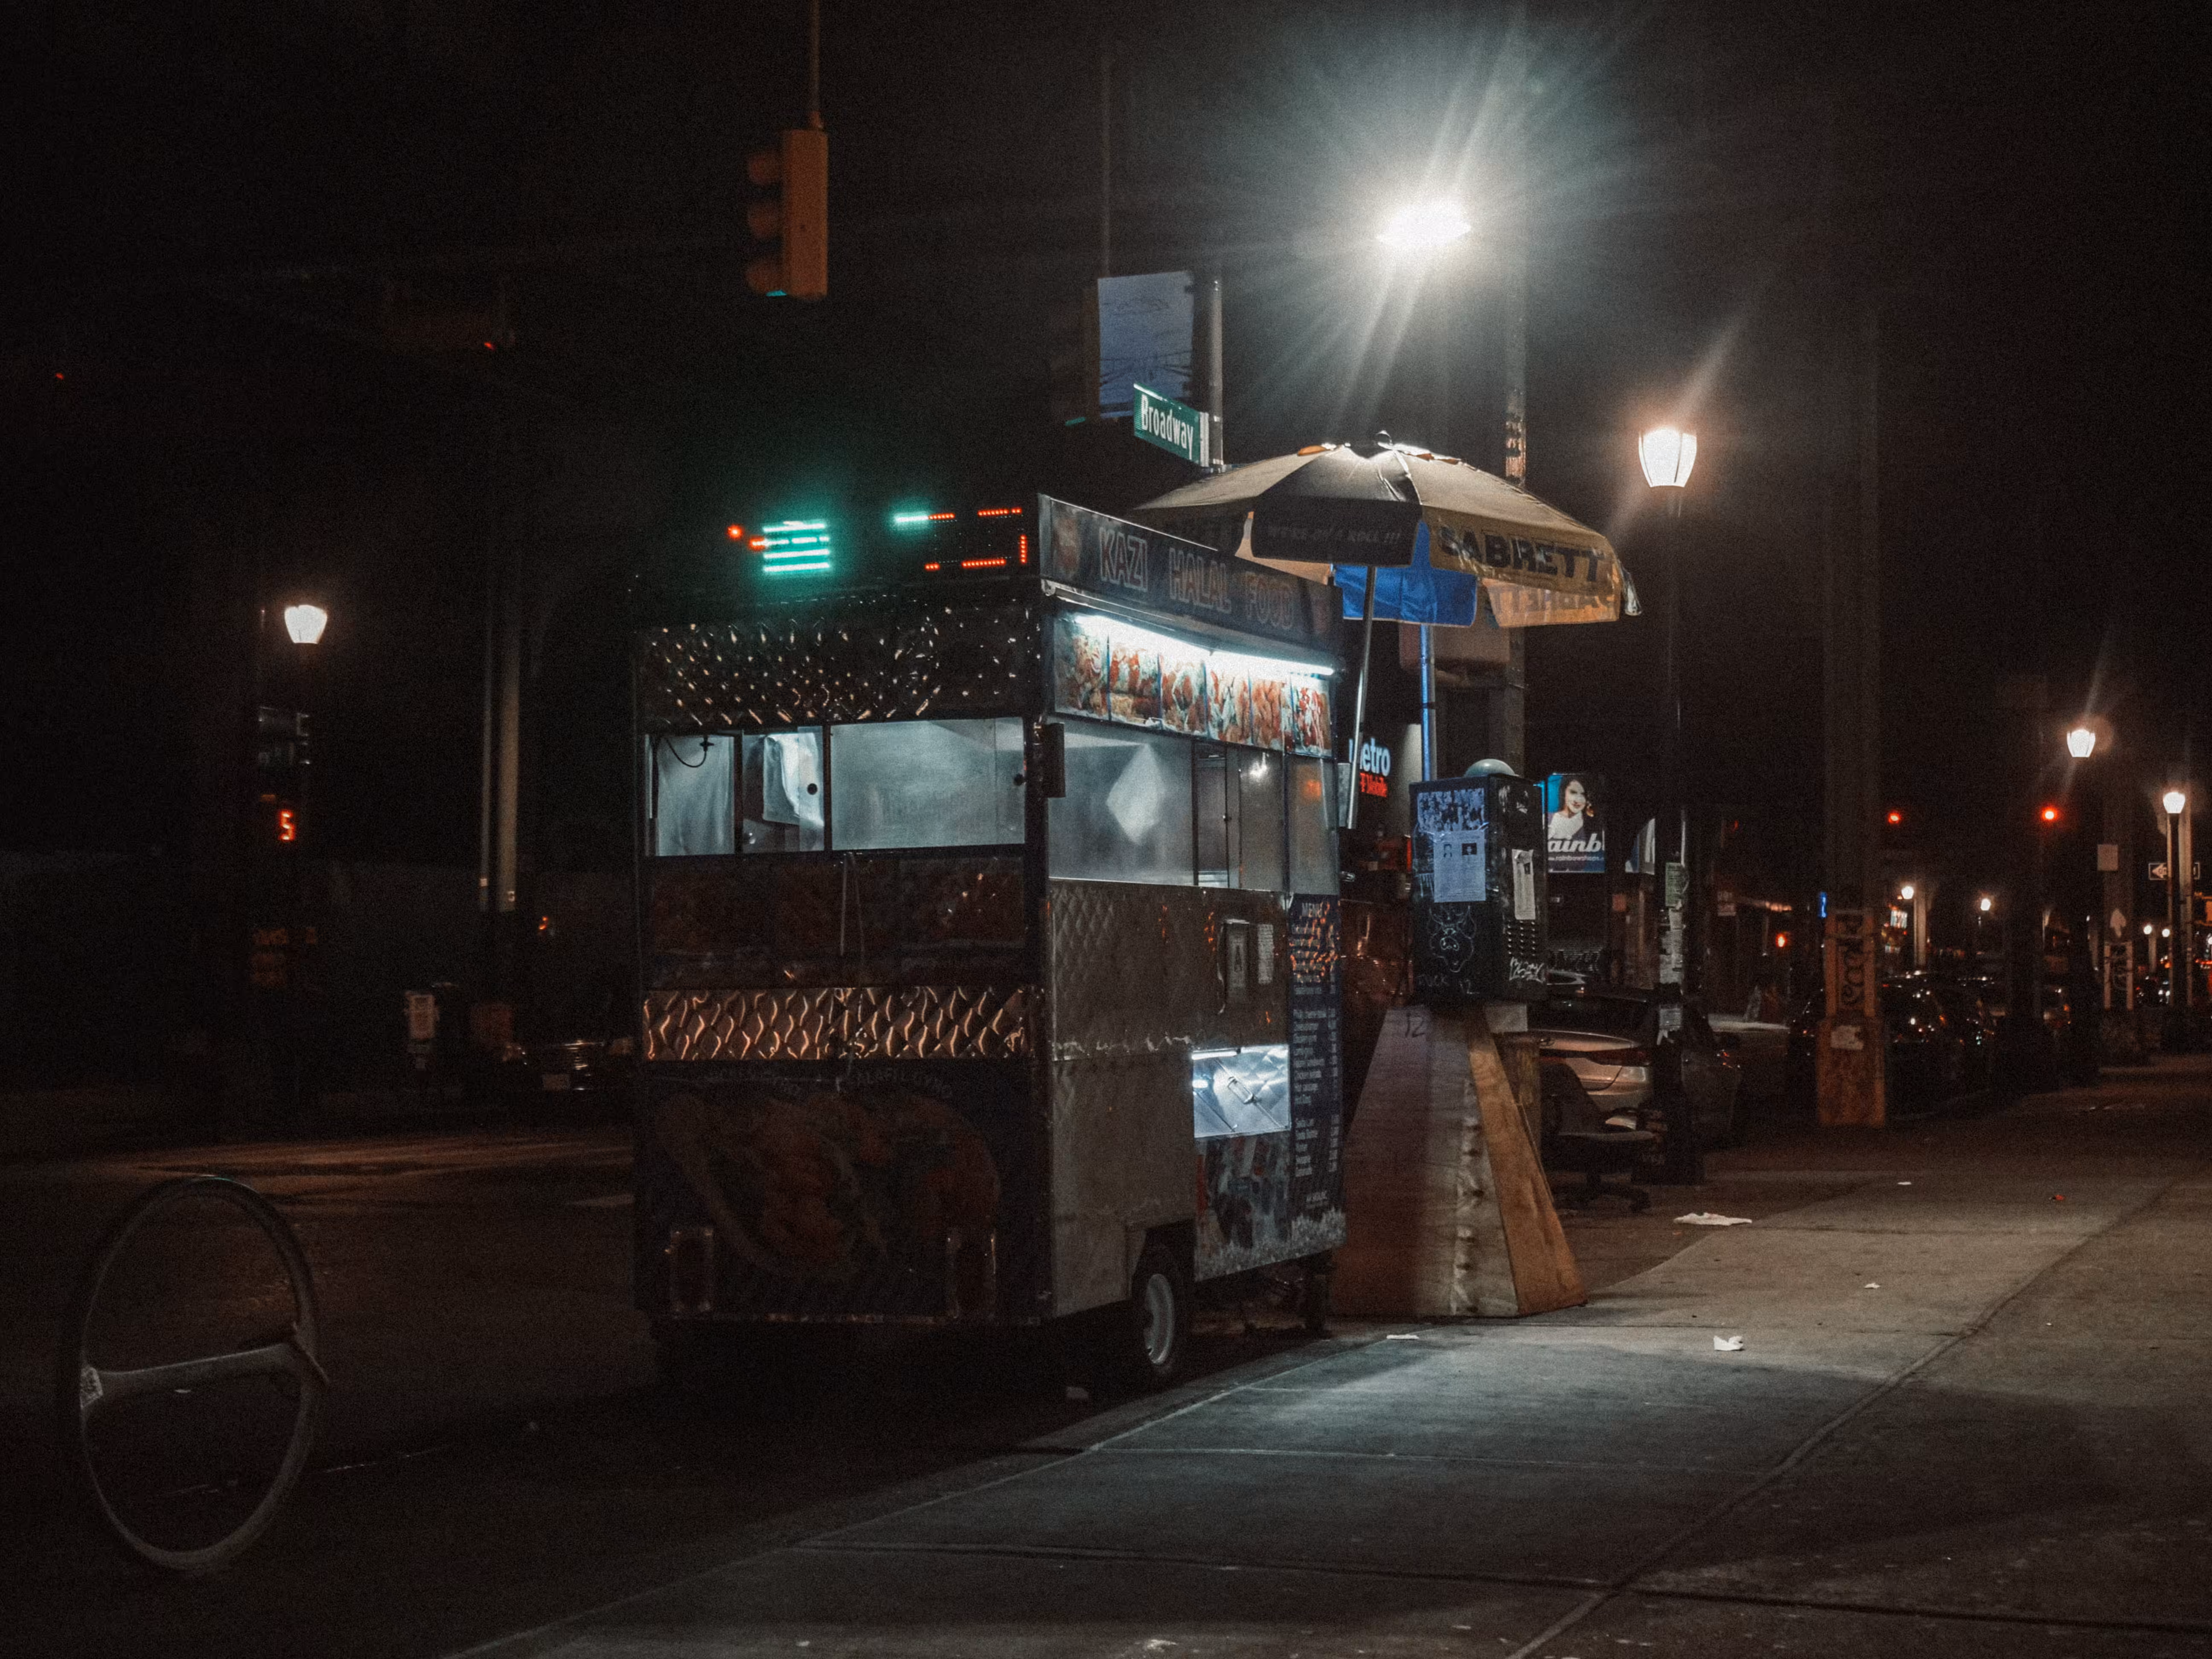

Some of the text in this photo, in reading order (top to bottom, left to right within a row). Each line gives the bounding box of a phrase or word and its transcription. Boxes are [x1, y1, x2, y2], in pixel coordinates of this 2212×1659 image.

[1141, 394, 1194, 460] Broadway
[1439, 526, 1605, 583] SABRETT
[1098, 526, 1295, 631] KAZI HALAL FOOD
[279, 809, 295, 841] 5
[1458, 978, 1480, 995] 12
[1404, 1012, 1426, 1038] 12
